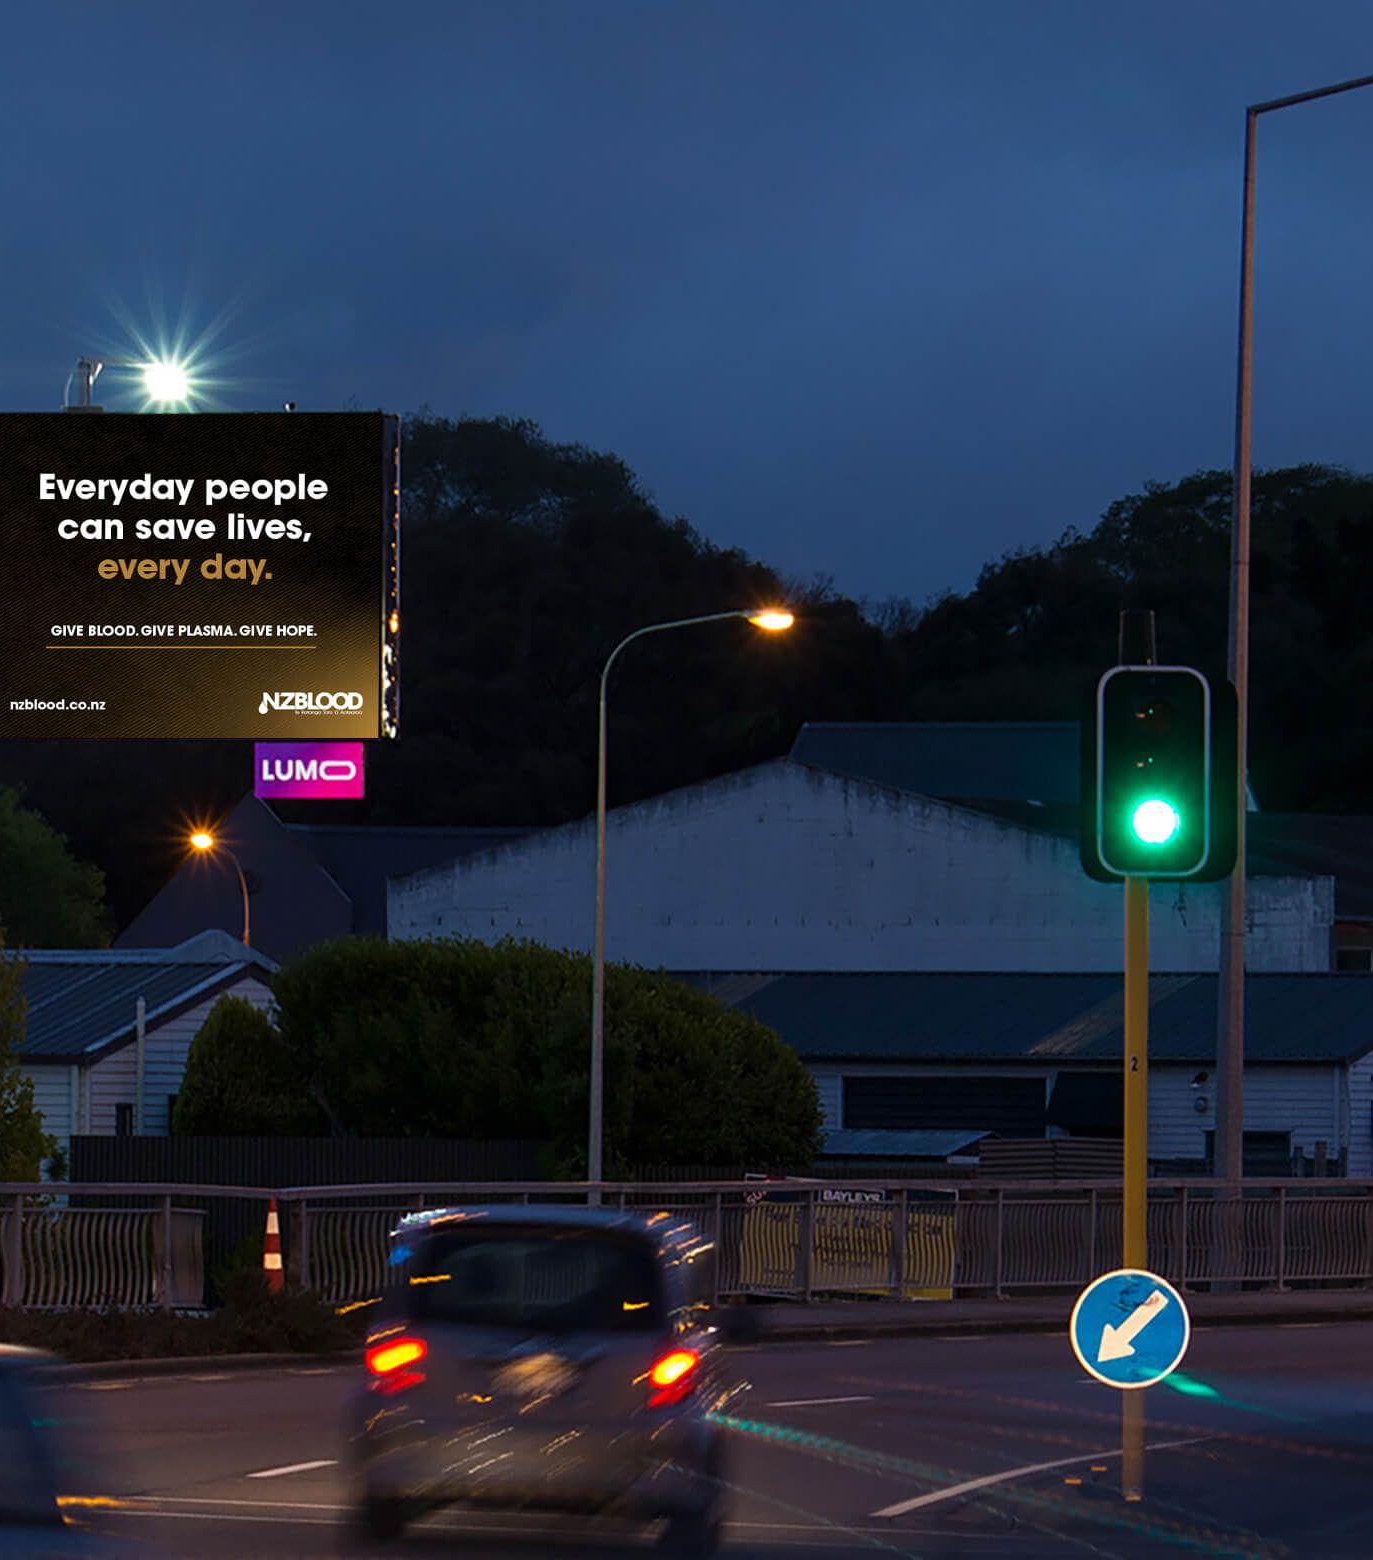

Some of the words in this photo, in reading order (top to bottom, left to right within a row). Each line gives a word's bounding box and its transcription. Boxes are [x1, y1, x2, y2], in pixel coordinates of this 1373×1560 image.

[39, 473, 194, 505] Everyday
[206, 473, 328, 505] people
[58, 518, 124, 540] can
[135, 518, 216, 540] save
[228, 513, 311, 542] lives,
[98, 558, 191, 585] every
[200, 552, 273, 585] day.
[51, 625, 84, 637] GIVE
[88, 625, 138, 637] BLOOD.
[141, 625, 174, 637] GIVE
[178, 625, 237, 637] PLASMA.
[239, 625, 272, 637] GIVE
[276, 625, 317, 637] HOPE.
[10, 699, 106, 710] nzblood.co.nz
[260, 692, 363, 711] NZBLOOD
[262, 759, 357, 781] LUMO
[1131, 1056, 1139, 1072] 2
[823, 1190, 880, 1202] BAYLEYS
